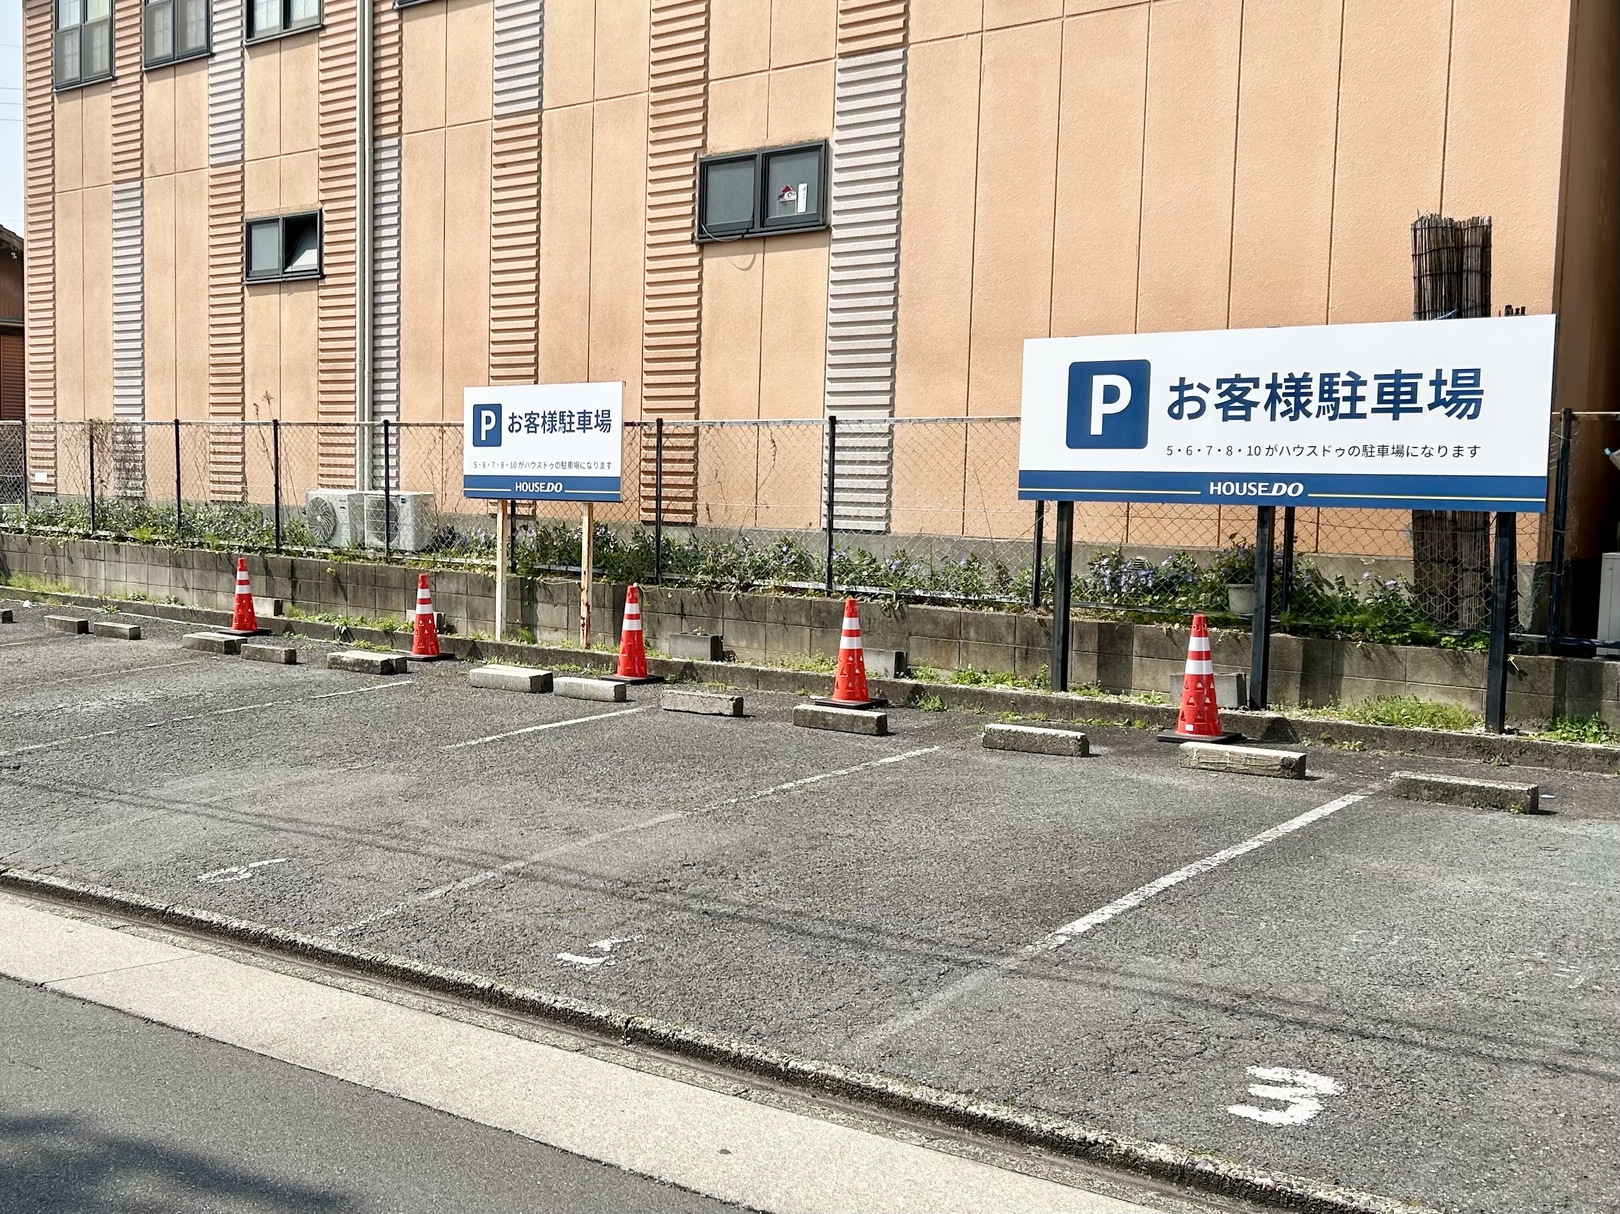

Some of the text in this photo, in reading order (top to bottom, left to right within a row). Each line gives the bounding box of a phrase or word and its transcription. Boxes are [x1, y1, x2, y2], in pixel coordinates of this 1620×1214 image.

[507, 409, 612, 434] お客様駐車場
[1089, 374, 1132, 436] P
[1166, 368, 1484, 423] お客様駐車場
[480, 409, 497, 441] P
[1226, 1064, 1345, 1126] 3
